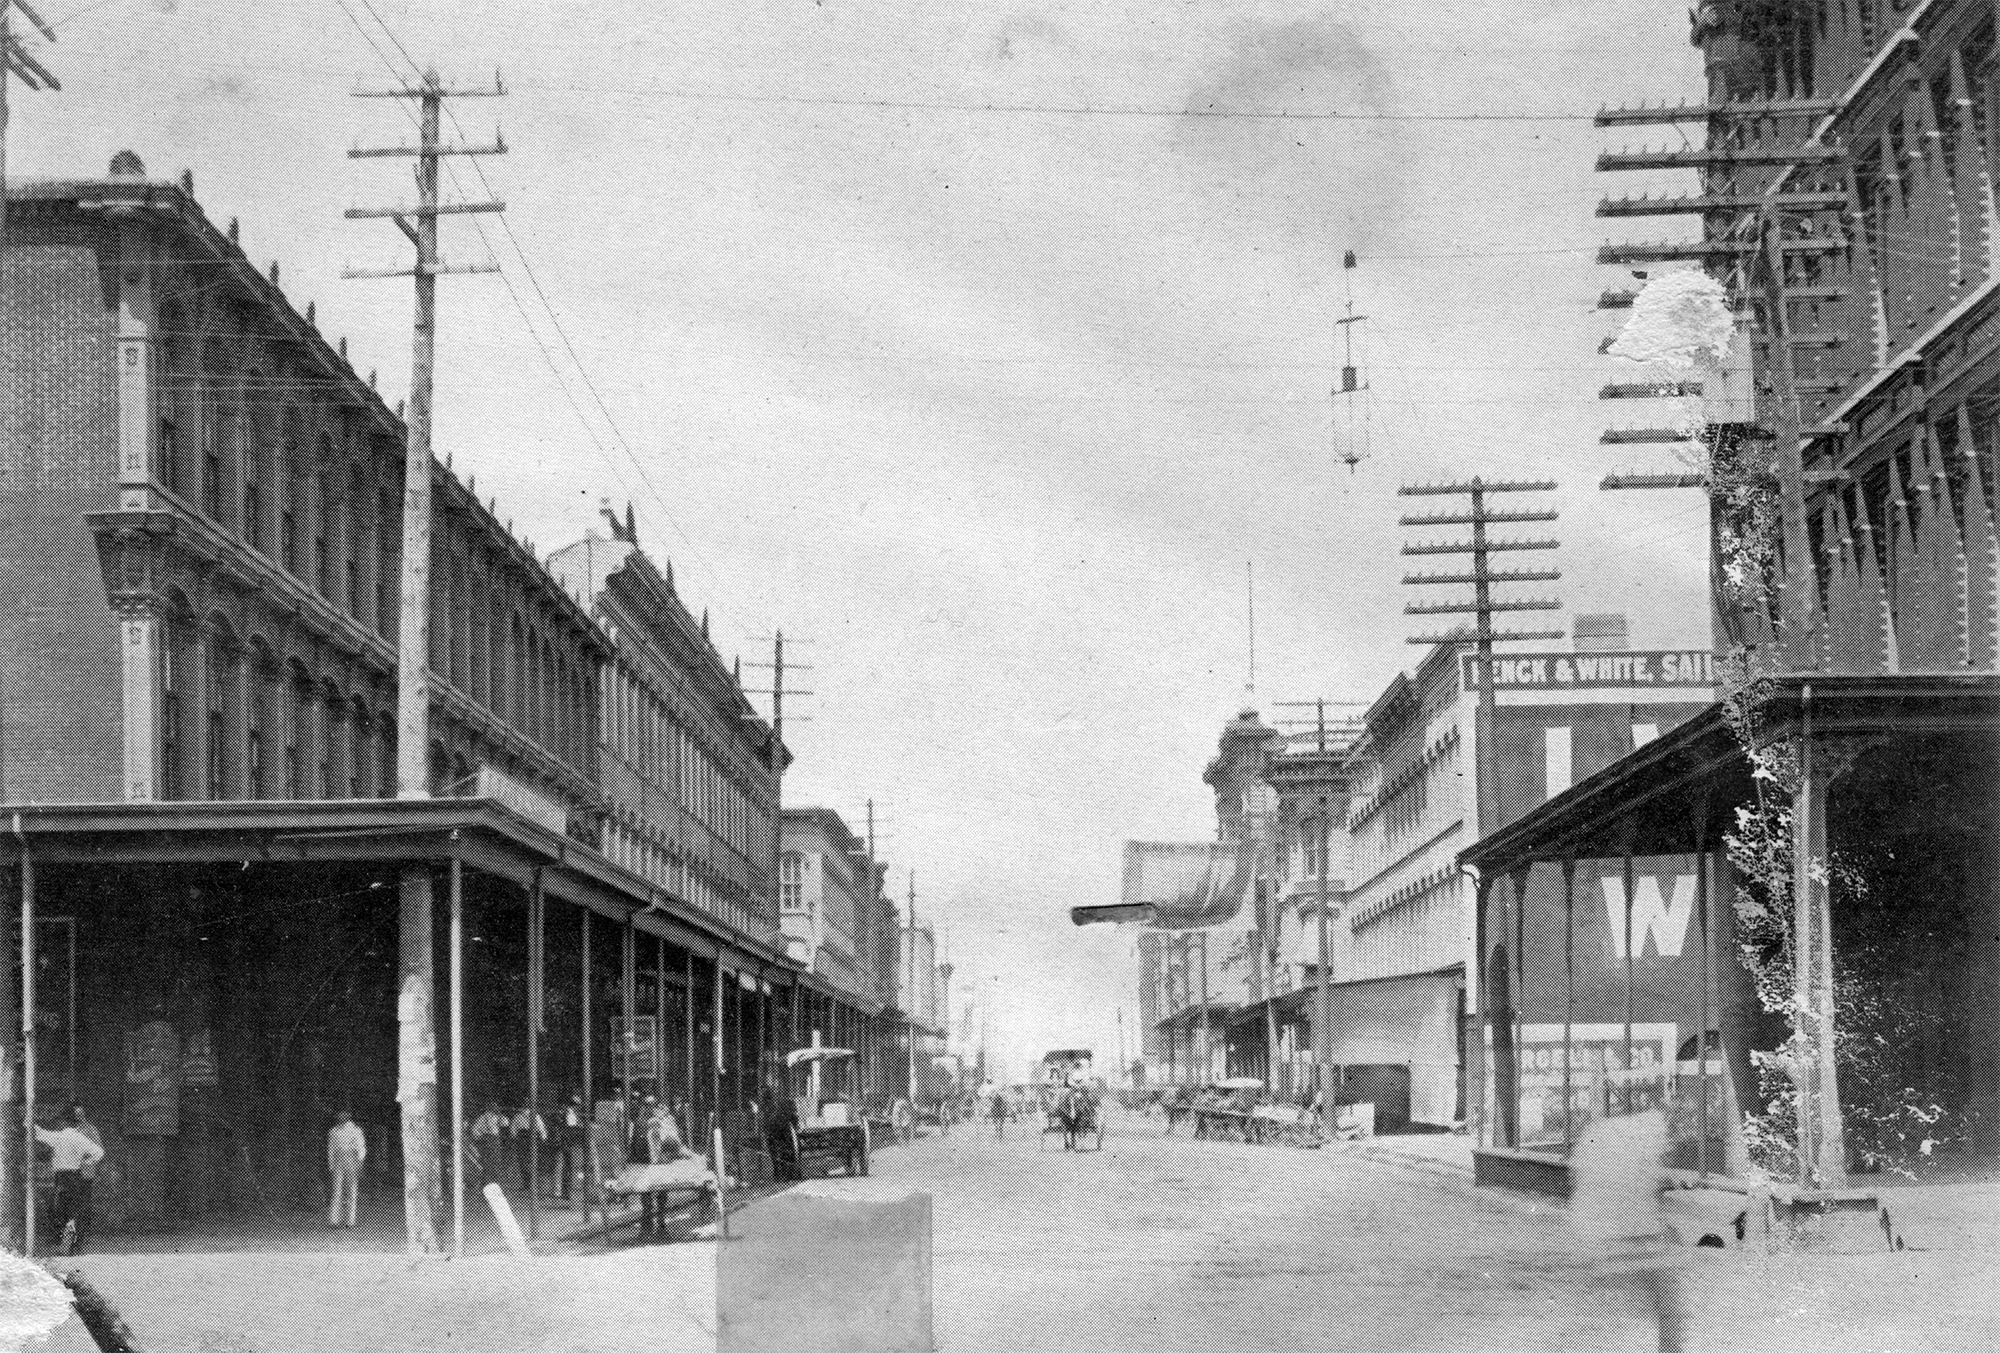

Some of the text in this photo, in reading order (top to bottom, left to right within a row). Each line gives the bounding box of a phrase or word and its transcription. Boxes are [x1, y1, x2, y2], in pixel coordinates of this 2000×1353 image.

[1555, 657, 1575, 683] &
[1575, 655, 1653, 682] WHITE,
[1600, 874, 1698, 960] W
